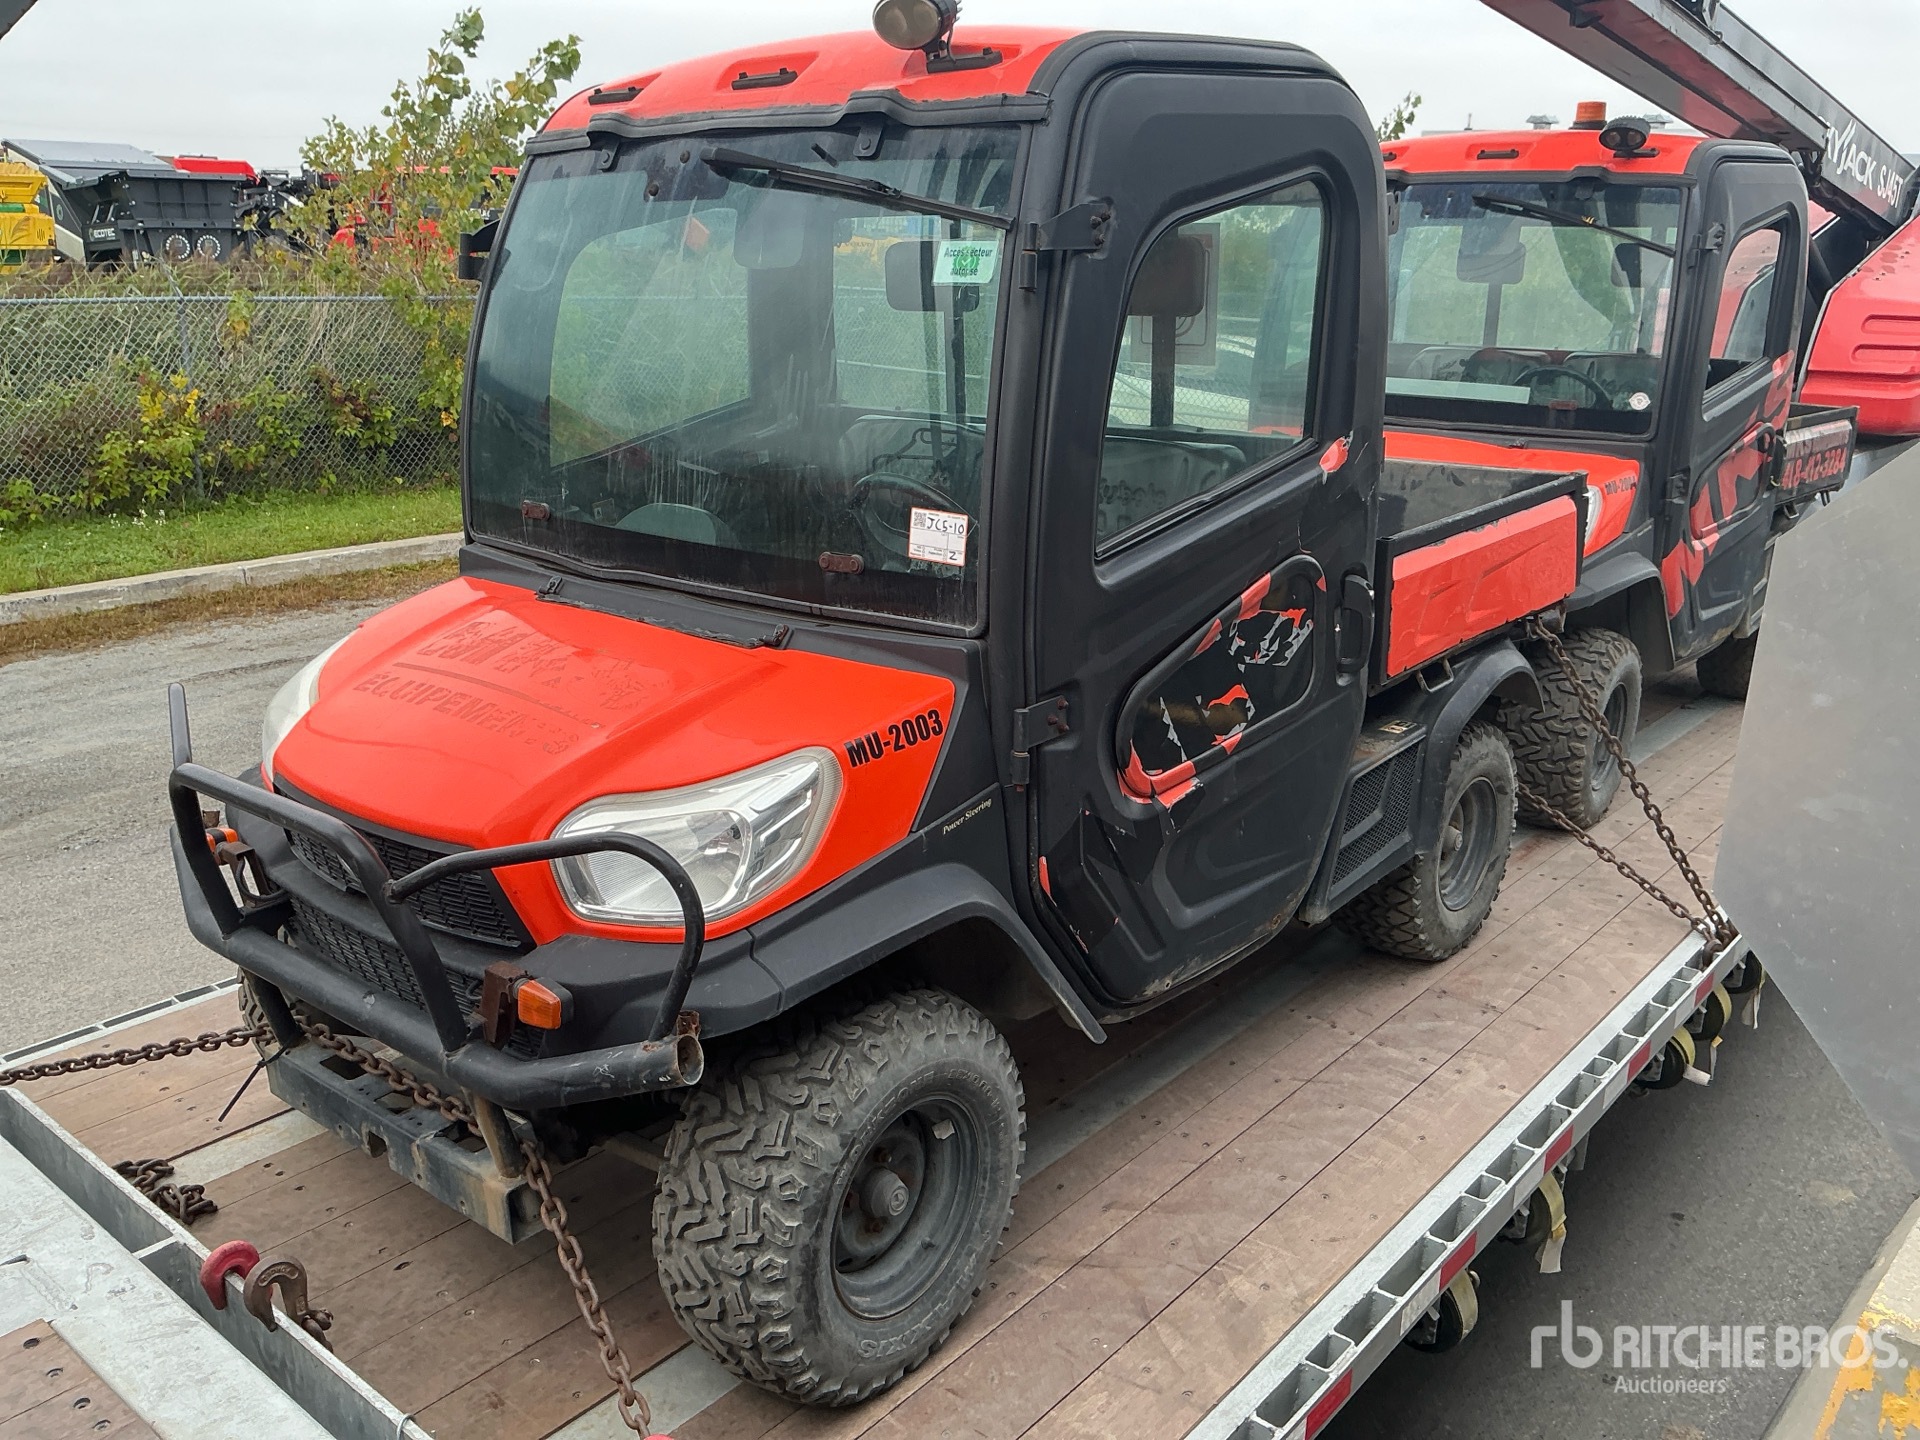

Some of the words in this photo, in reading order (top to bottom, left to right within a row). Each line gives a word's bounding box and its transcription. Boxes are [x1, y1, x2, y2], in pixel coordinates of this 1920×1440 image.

[845, 709, 943, 768] MU-2003
[942, 816, 966, 835] Power
[965, 798, 993, 820] Steering
